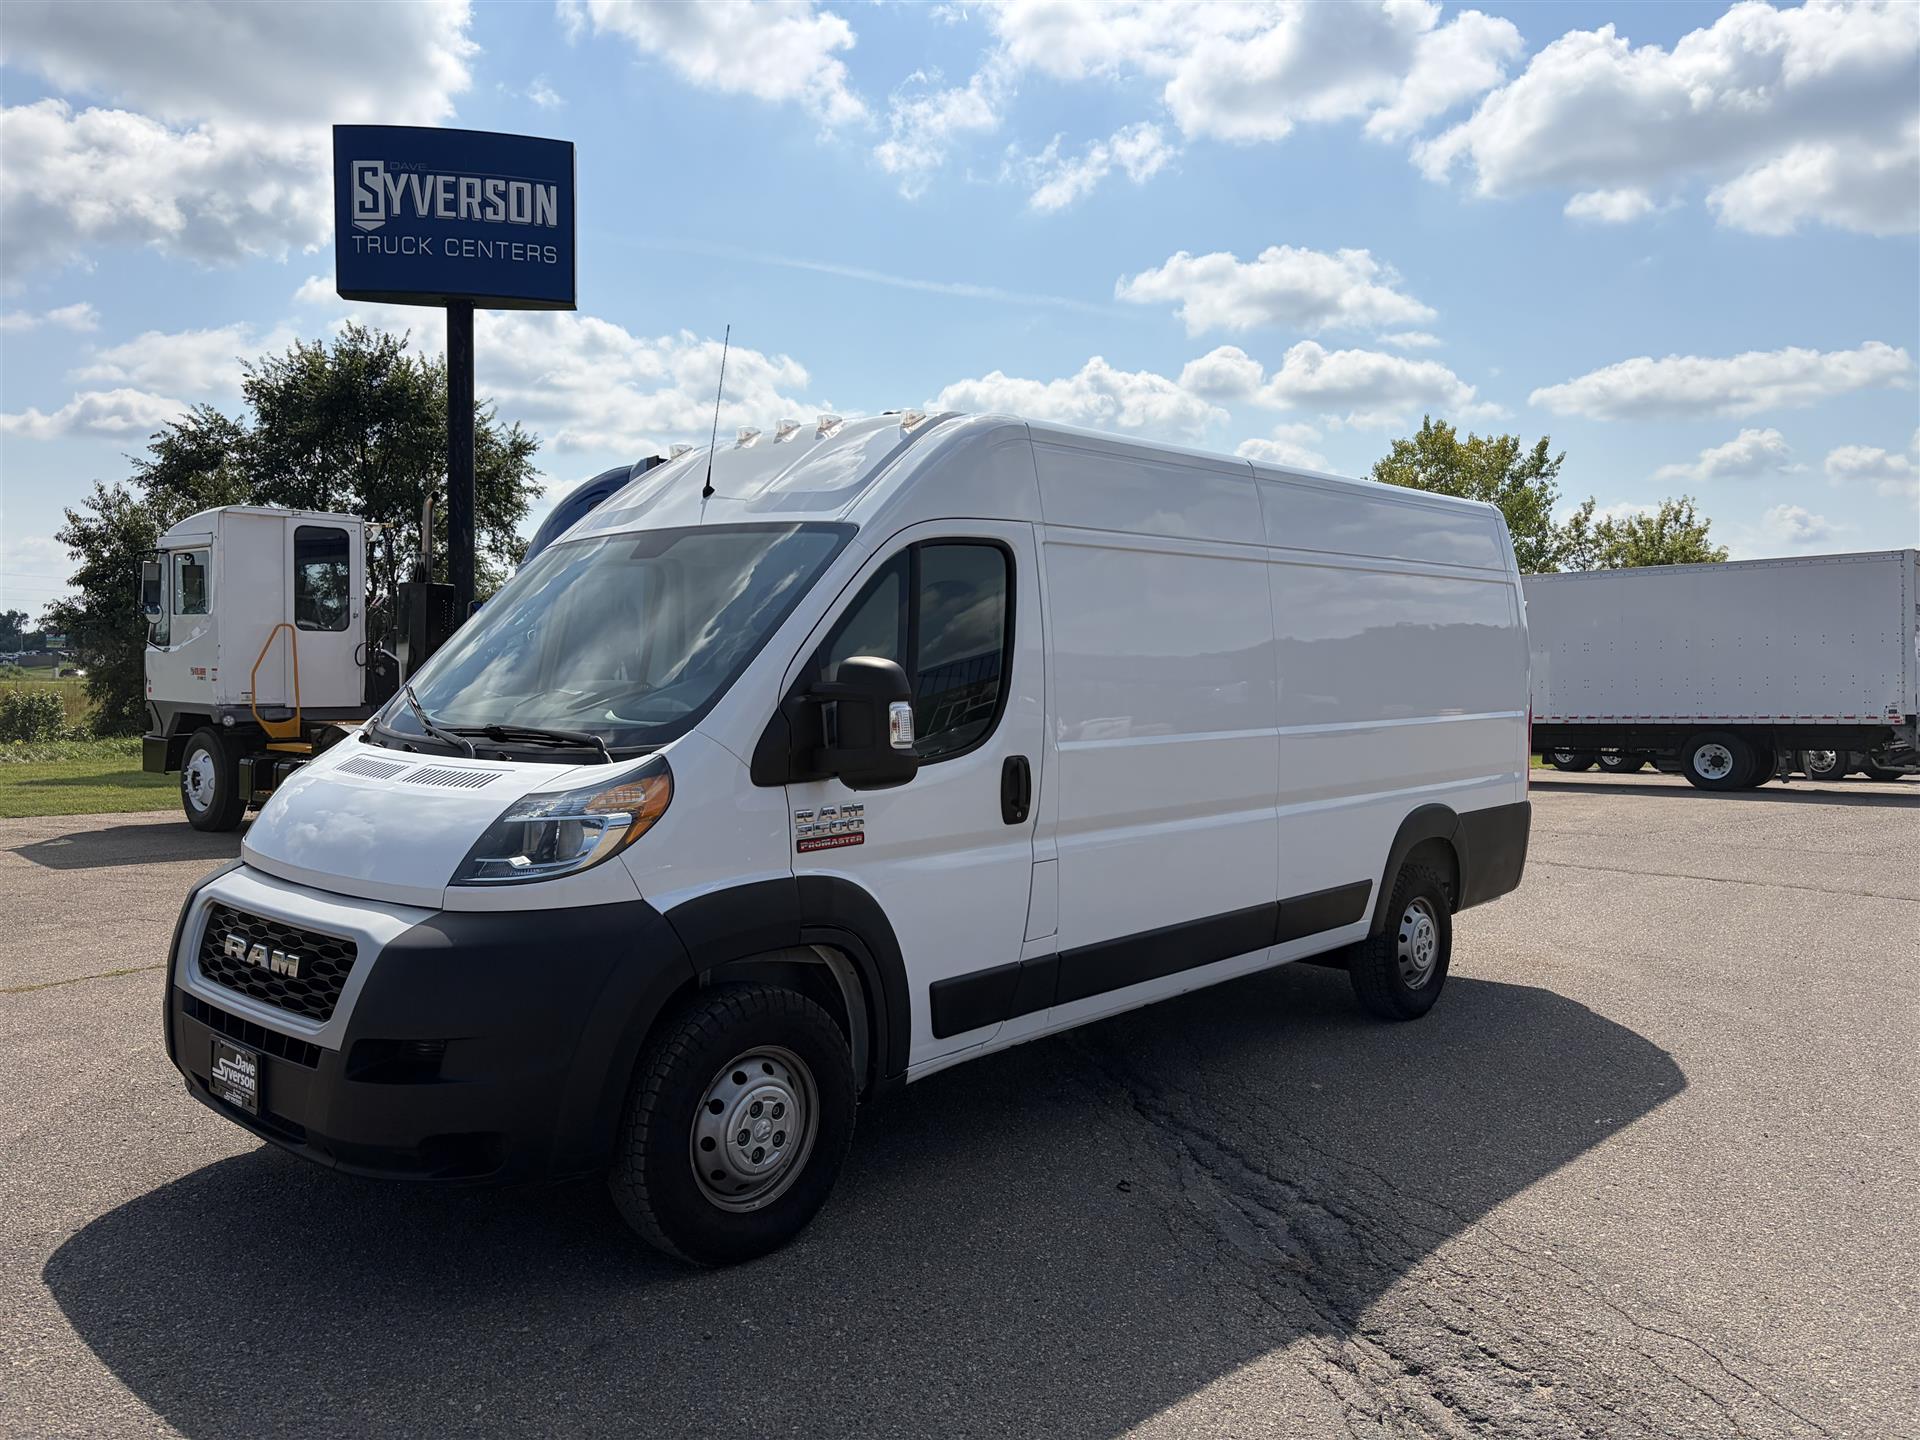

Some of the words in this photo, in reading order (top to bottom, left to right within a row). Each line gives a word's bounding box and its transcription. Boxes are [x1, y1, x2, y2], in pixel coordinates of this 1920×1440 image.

[390, 161, 428, 171] DAVE
[352, 160, 558, 228] SYVERSON
[352, 235, 433, 256] TRUCK
[444, 238, 558, 264] CENTERS
[794, 802, 864, 824] RAM
[224, 934, 300, 978] RAM
[212, 1057, 255, 1091] Syverson
[235, 1054, 255, 1076] Dave
